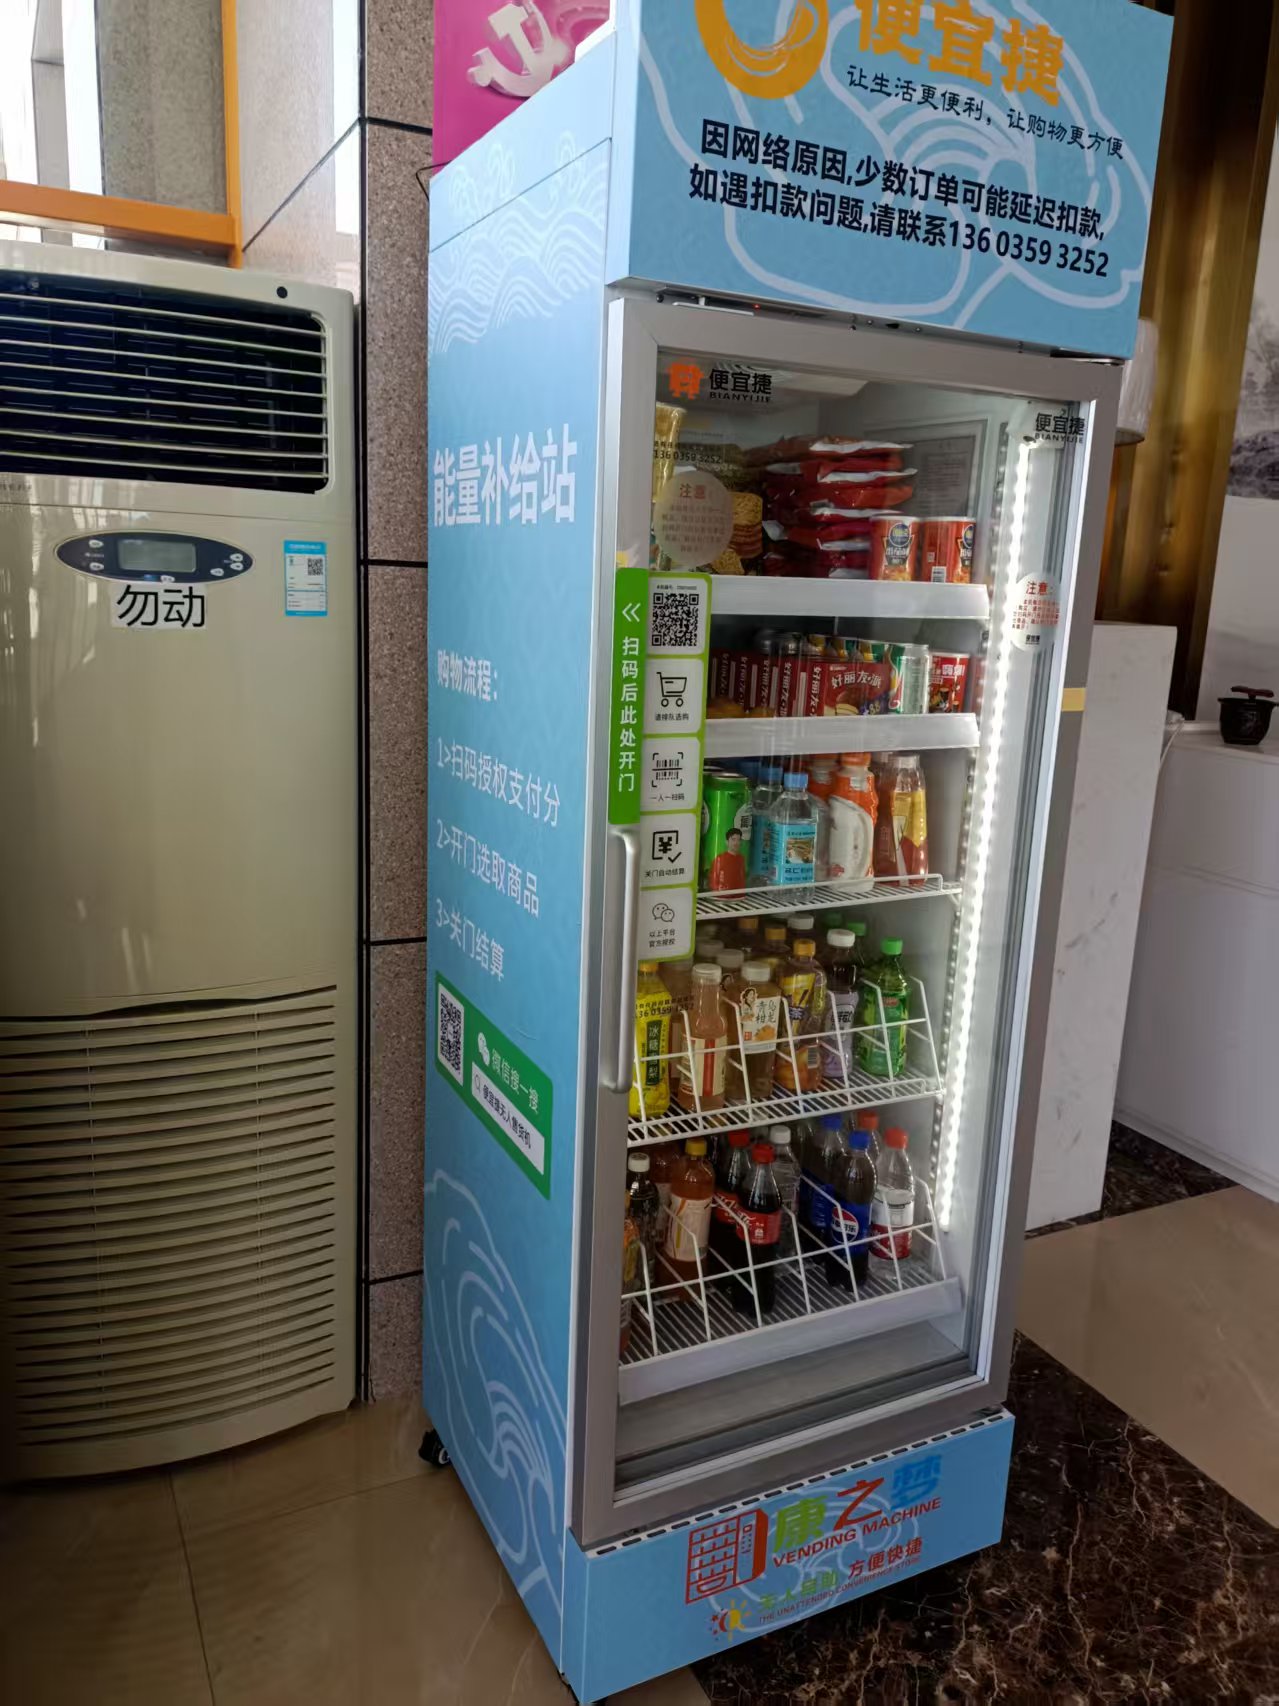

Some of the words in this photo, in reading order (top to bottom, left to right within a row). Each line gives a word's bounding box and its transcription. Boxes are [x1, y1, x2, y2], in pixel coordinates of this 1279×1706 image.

[854, 0, 1064, 107] 便宜捷
[996, 231, 1052, 266] 0359
[1056, 243, 1109, 278] 3252
[709, 368, 773, 395] 便宜捷
[1035, 412, 1085, 436] 便宜捷
[433, 423, 577, 527] 能量补给站
[116, 584, 206, 629] 勿动
[617, 636, 640, 792] 扫码后此处开门
[773, 1528, 857, 1568] VENDING
[862, 1497, 941, 1536] MACHINE
[848, 1536, 923, 1579] 方便快捷
